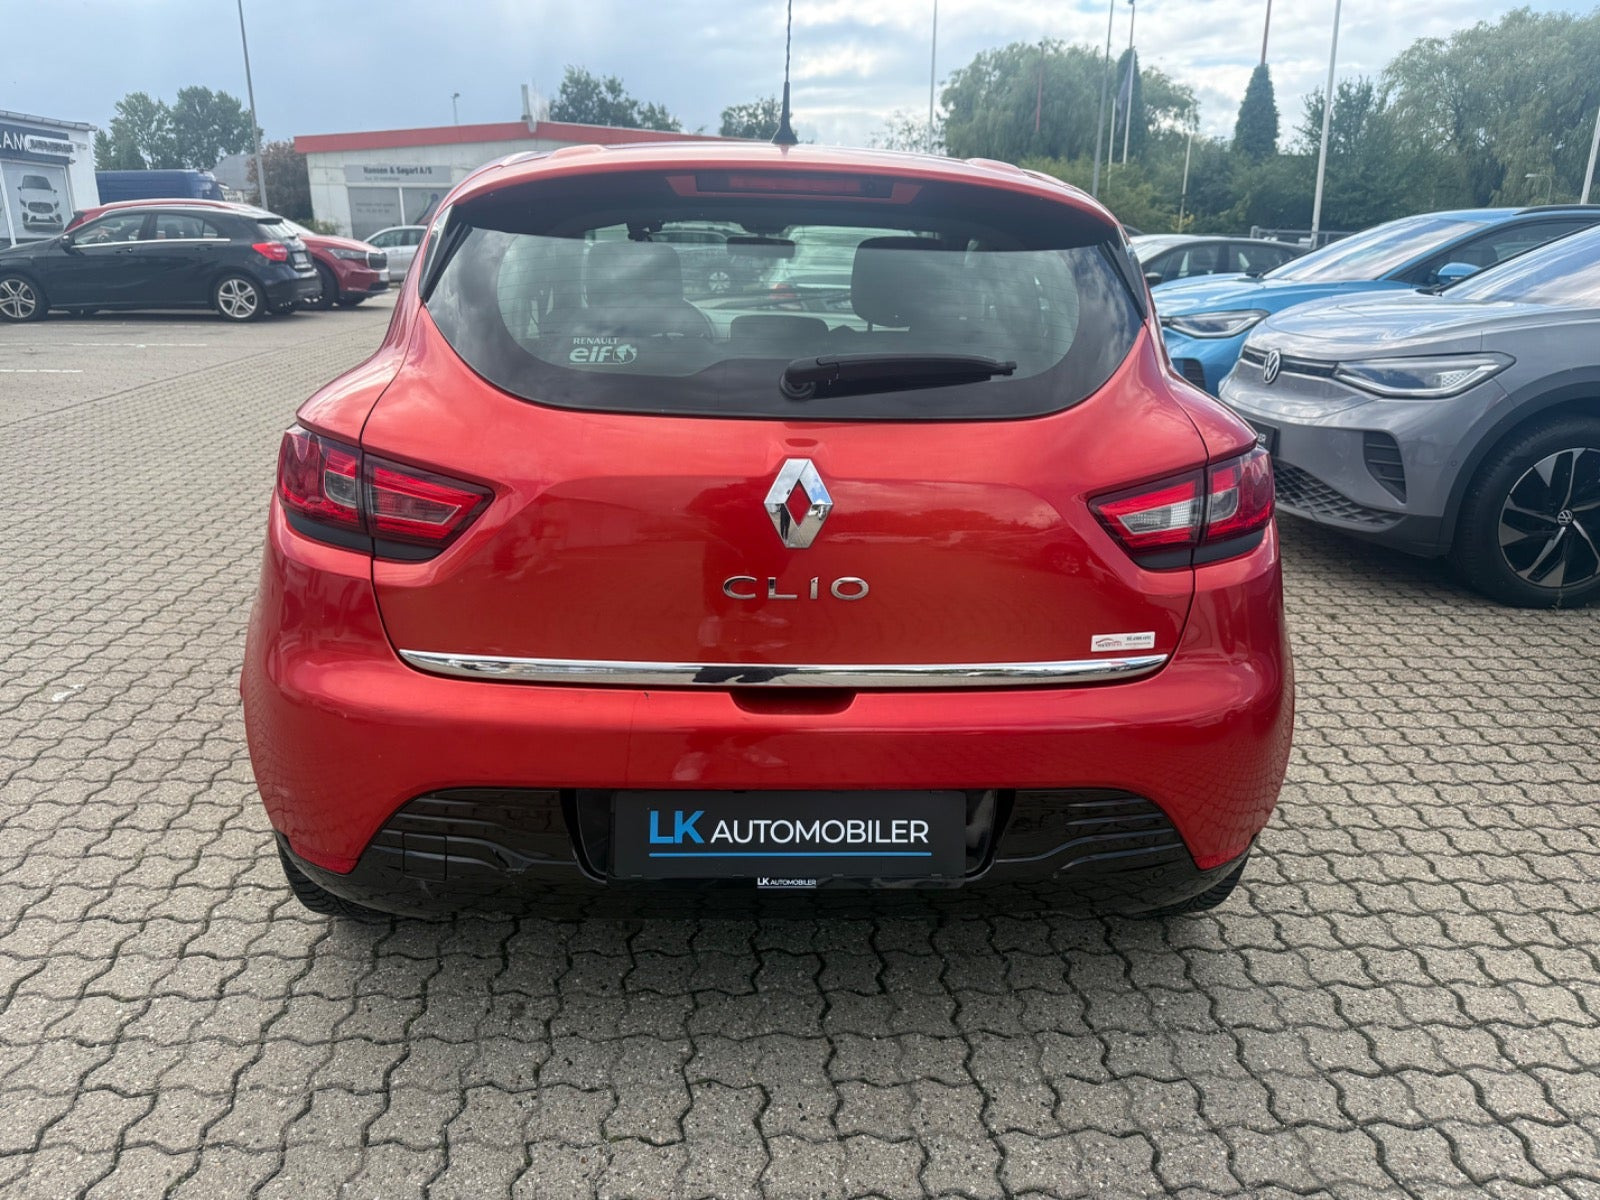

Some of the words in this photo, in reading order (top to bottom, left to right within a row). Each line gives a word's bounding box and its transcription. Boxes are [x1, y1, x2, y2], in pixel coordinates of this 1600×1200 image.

[569, 345, 613, 362] elf
[723, 575, 870, 600] CLIO
[650, 810, 705, 844] LK
[710, 819, 929, 844] AUTOMOBILER
[757, 877, 769, 886] LK
